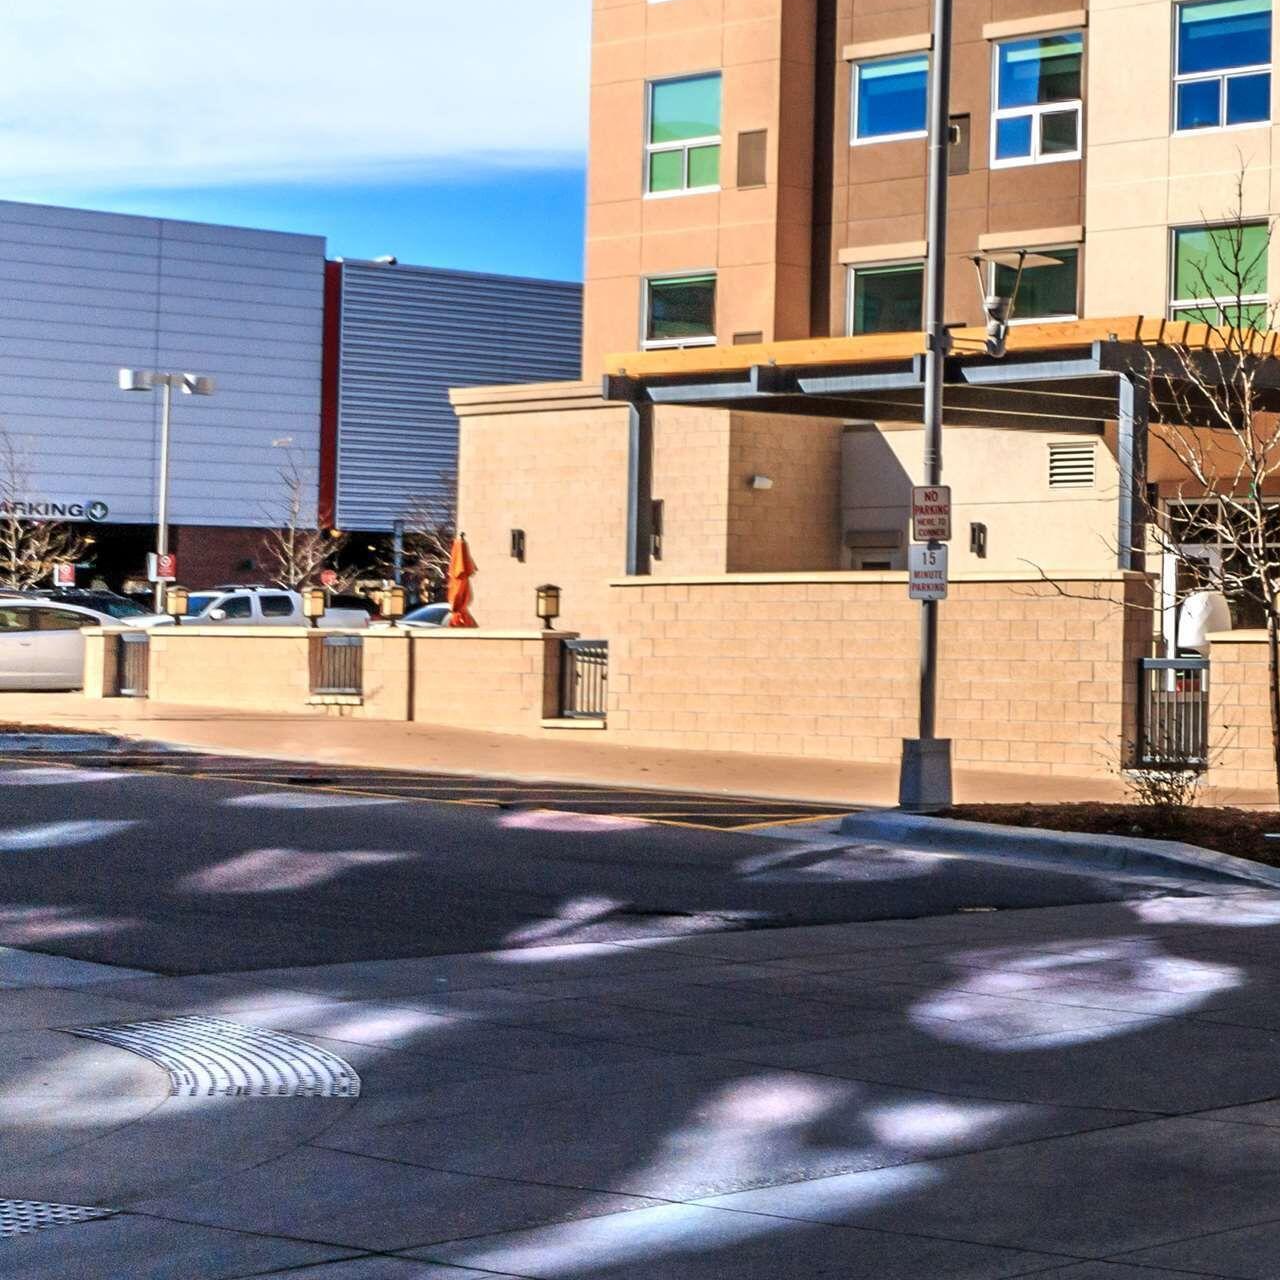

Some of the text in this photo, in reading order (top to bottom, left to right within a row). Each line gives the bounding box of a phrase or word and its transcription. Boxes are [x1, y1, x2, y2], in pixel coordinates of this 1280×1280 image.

[924, 490, 938, 502] NO
[912, 504, 950, 515] PARKING
[922, 551, 937, 566] 15
[913, 570, 944, 580] MINUTE
[911, 583, 946, 592] PARKING
